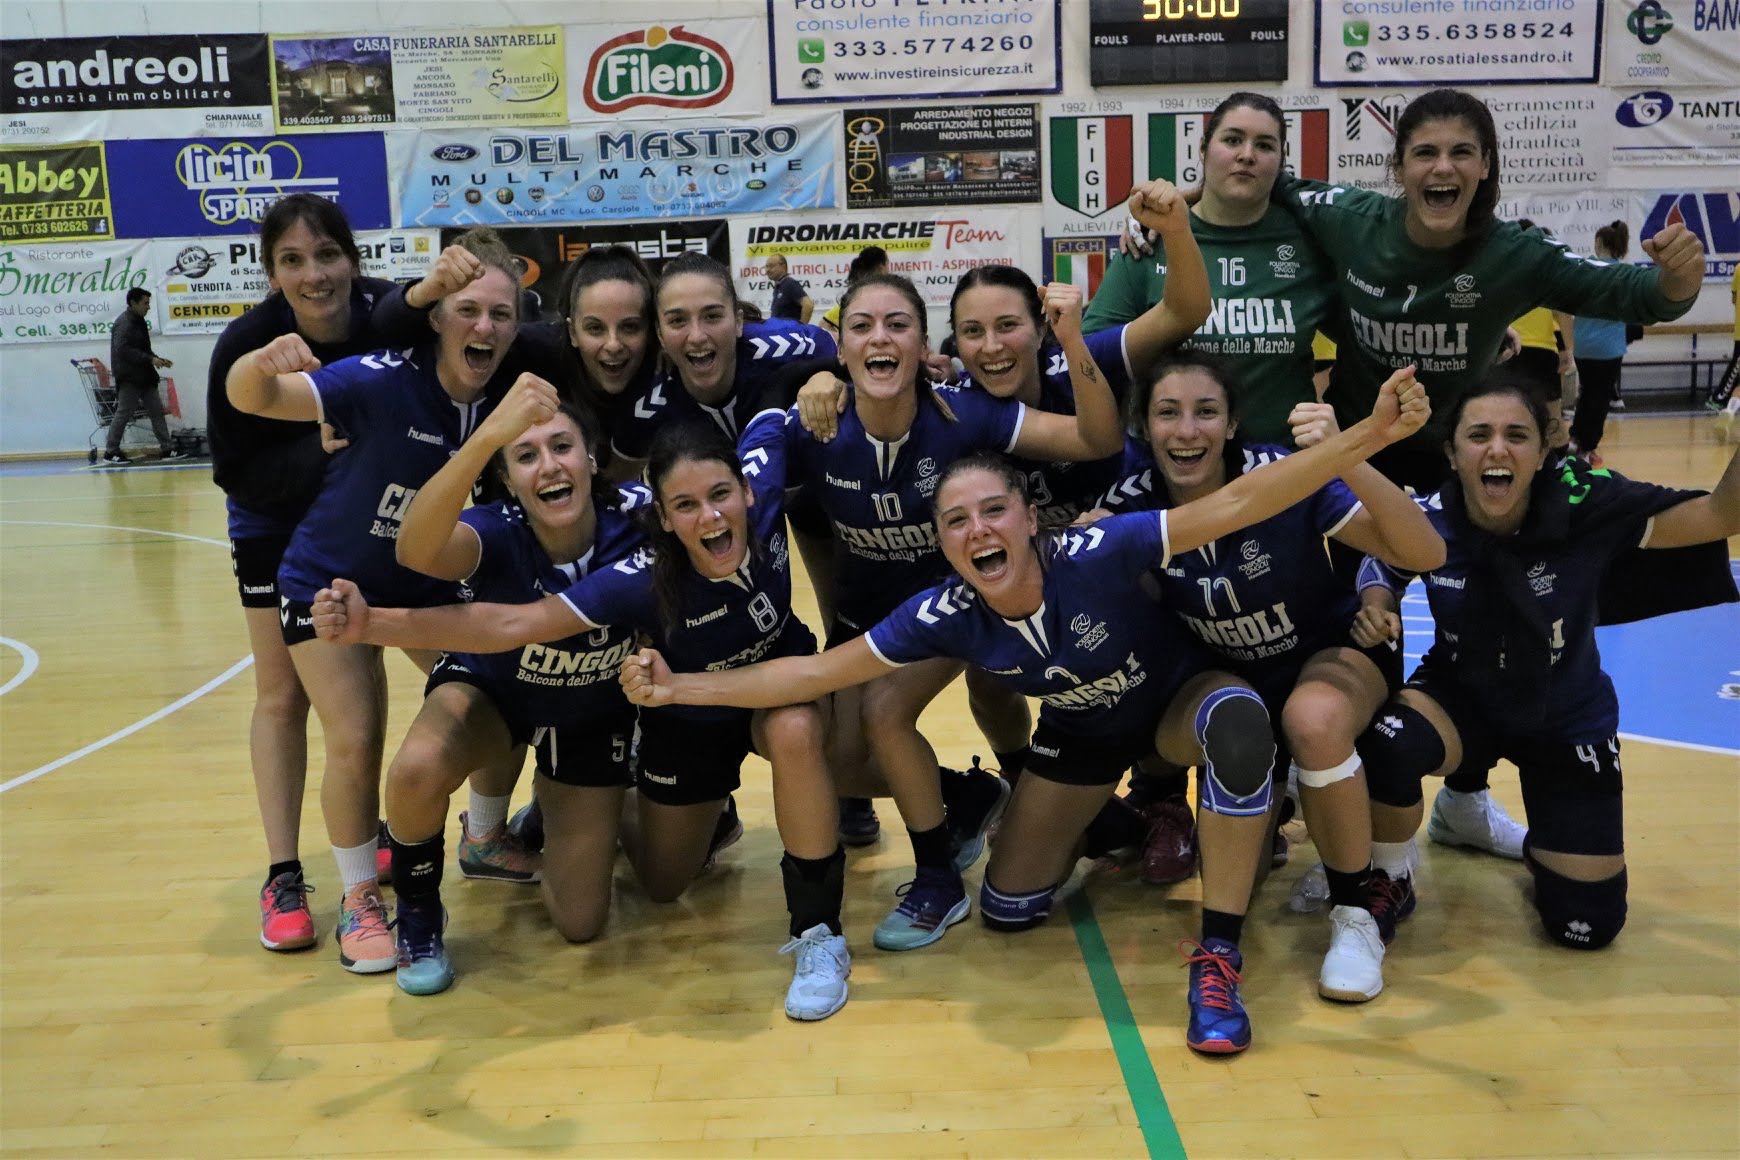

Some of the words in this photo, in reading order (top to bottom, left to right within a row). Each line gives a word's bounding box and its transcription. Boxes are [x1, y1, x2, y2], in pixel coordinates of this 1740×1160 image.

[1343, 0, 1455, 15] consulente
[1694, 0, 1740, 31] BAN
[796, 13, 911, 32] consulente
[919, 8, 1033, 27] finanziario
[1094, 35, 1129, 45] FOULS
[1156, 32, 1225, 44] PLAYER-FOUL
[1250, 30, 1285, 41] FOULS
[1378, 22, 1574, 41] 335.6358524
[353, 38, 390, 52] CASA
[393, 37, 470, 50] FUNERARIA
[474, 33, 557, 48] SANTARELLI
[833, 35, 1033, 58] 333.5774260
[1376, 50, 1574, 66] www.rosatialessandro.it
[1636, 53, 1663, 64] CREDITO
[13, 46, 230, 88] andreoli
[607, 51, 710, 94] Fileni
[834, 62, 1034, 81] www.investireinsicurezza.it
[416, 73, 452, 81] ANCONA
[492, 67, 556, 86] Santarelli
[17, 91, 97, 107] agenzia
[108, 88, 232, 102] immobiliare
[413, 90, 457, 98] FABRIANO
[1292, 95, 1320, 106] 2000
[399, 99, 430, 107] MONTE
[431, 98, 449, 106] SAN
[418, 106, 455, 114] CINGOLI
[1060, 102, 1087, 113] 1992
[1097, 101, 1123, 112] 1993
[1159, 98, 1185, 109] 1994
[205, 112, 263, 122] CHIARAVALLE
[283, 117, 299, 125] 339
[300, 115, 335, 124] 4035497
[341, 114, 357, 123] 333
[358, 113, 392, 122] 2497511
[913, 108, 992, 120] ARREDAMENTO
[993, 106, 1032, 117] NEGOZI
[8, 120, 27, 128] JESI
[900, 120, 980, 131] PROGETTAZIONE
[981, 119, 992, 128] DI
[994, 118, 1032, 128] INTERNI
[1504, 114, 1577, 131] edilizia
[938, 130, 995, 140] INDUSTRIAL
[996, 128, 1032, 139] DESIGN
[441, 146, 470, 160] Ford
[489, 134, 584, 167] DEL
[596, 123, 800, 164] MASTRO
[1502, 152, 1585, 168] lettricità
[0, 160, 99, 198] Abbey
[0, 201, 104, 221] AFFETTERIA
[506, 210, 547, 218] CINGOLI
[551, 208, 566, 216] MC
[1, 225, 19, 236] Tel.
[22, 222, 48, 235] 0733
[50, 220, 88, 233] 602626
[747, 220, 936, 244] IDROMARCHE
[936, 219, 1006, 250] Team
[1063, 221, 1107, 233] ALLIEVI
[28, 248, 95, 262] Ristorante
[748, 245, 764, 254] Vi
[769, 243, 846, 253] serviamo
[884, 240, 931, 251] pulire
[230, 268, 240, 276] di
[1217, 257, 1247, 287] 16
[190, 282, 232, 293] VENDITA
[1346, 268, 1386, 298] hummel
[1401, 284, 1418, 314] 7
[0, 305, 15, 316] sul
[18, 303, 51, 318] Lago
[53, 303, 66, 314] di
[67, 301, 111, 316] Cingoli
[172, 304, 231, 317] CENTRO
[1193, 297, 1297, 335] NGOLI
[15, 324, 52, 338] Cell.
[1350, 307, 1470, 356] CINGOLI
[1222, 337, 1251, 354] delle
[1254, 336, 1297, 354] Marche
[1422, 357, 1468, 373] Marche
[407, 426, 444, 446] hummel
[825, 471, 861, 491] hummel
[871, 492, 903, 522] 10
[243, 582, 275, 594] hummel
[1429, 571, 1466, 590] hummel
[685, 603, 729, 629] hummel
[747, 591, 779, 633] 8
[1257, 634, 1300, 660] Marche
[516, 667, 564, 687] Balcone
[566, 672, 595, 688] delle
[644, 769, 677, 785] hummel
